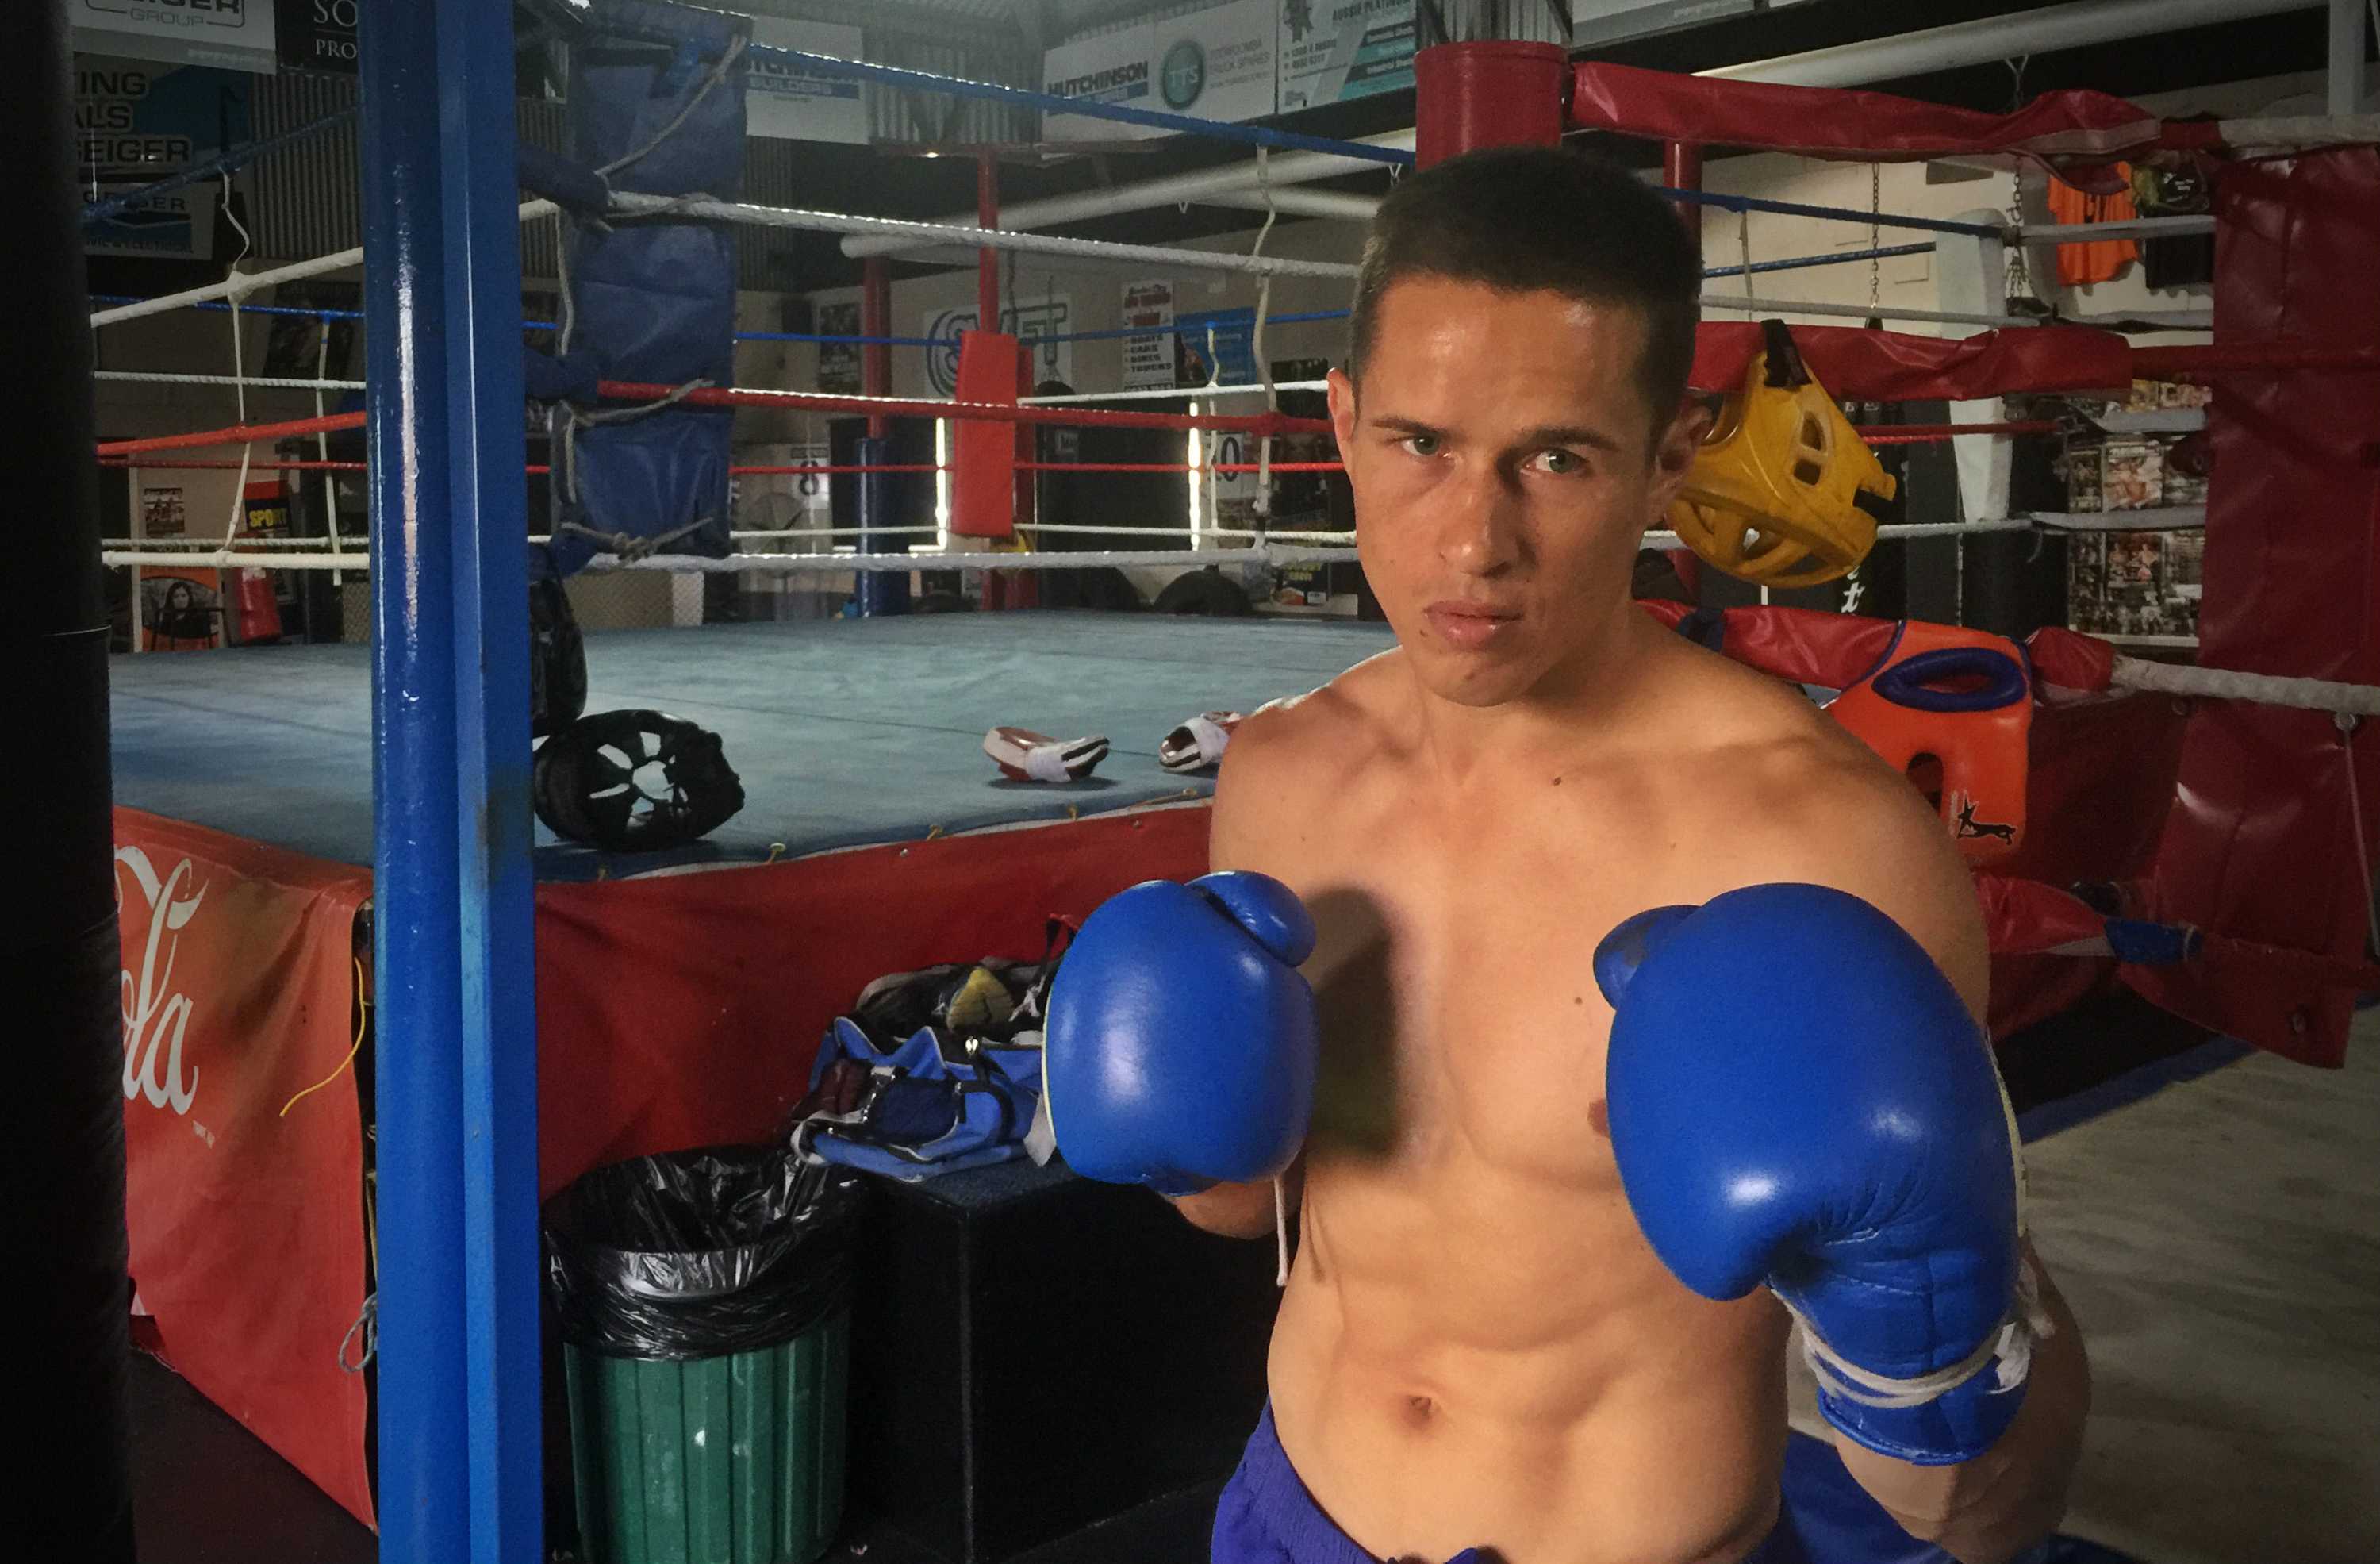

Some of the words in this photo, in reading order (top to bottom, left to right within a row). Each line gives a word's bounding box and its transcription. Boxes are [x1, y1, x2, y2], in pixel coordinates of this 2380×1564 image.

[129, 8, 204, 26] GROUP
[316, 39, 357, 59] PRO
[1047, 60, 1149, 96] HUTCHINSON
[1169, 65, 1199, 87] TTS
[77, 139, 190, 163] EIGER
[249, 509, 288, 528] SPORT
